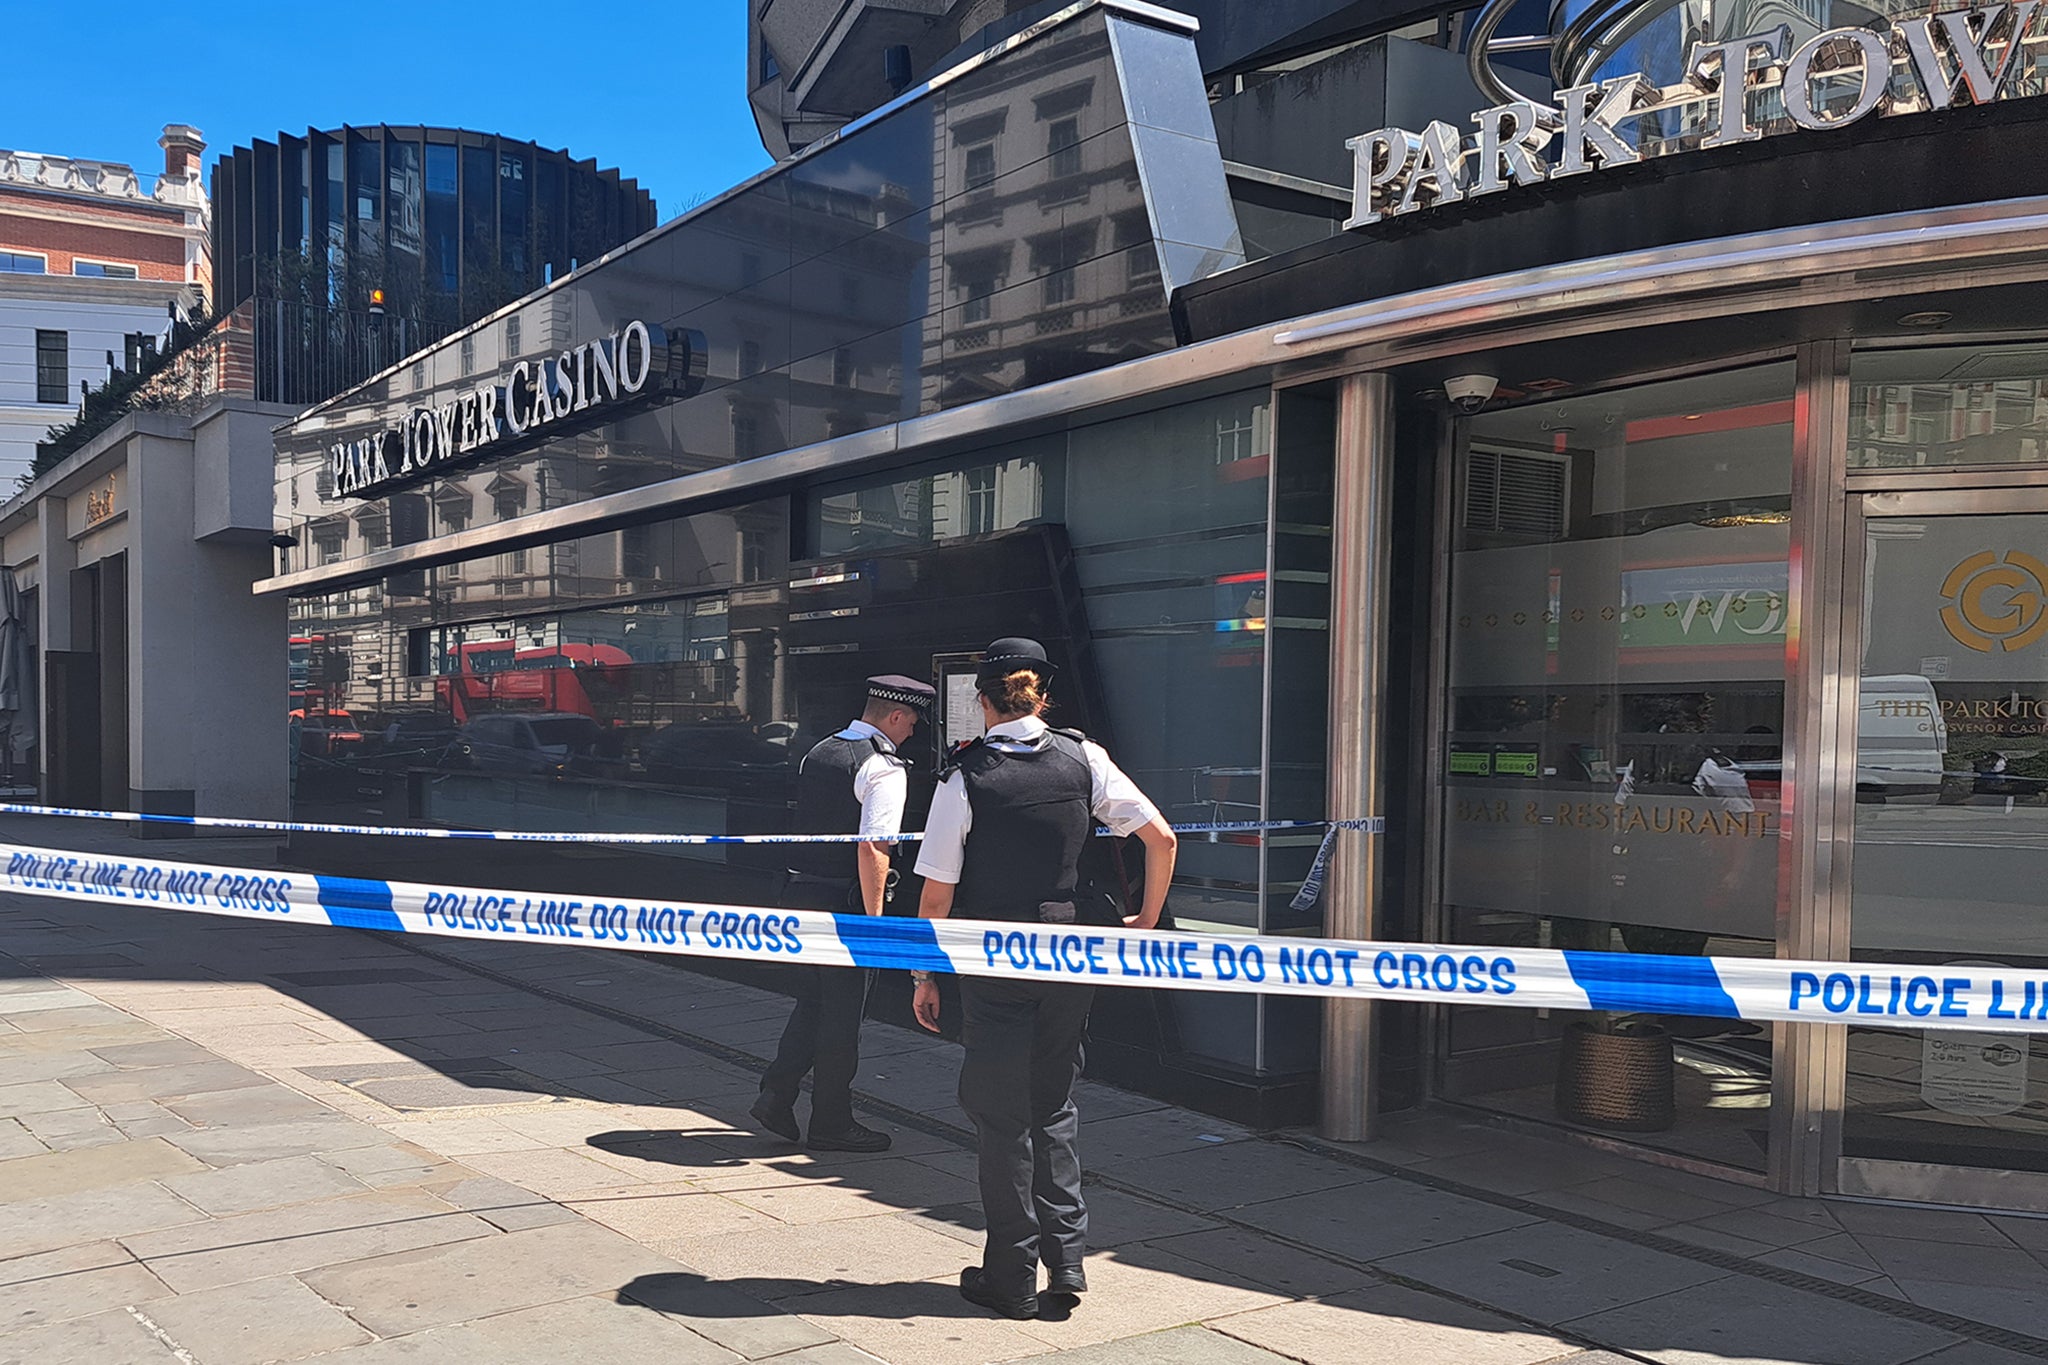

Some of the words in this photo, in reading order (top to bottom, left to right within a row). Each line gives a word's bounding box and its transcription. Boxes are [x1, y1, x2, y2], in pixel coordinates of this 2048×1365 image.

[1342, 72, 1642, 231] PARK
[331, 430, 390, 498] PARK
[398, 384, 499, 473] TOWER
[505, 320, 651, 434] CASINO
[1875, 699, 1930, 718] THE
[1938, 699, 2011, 719] PARK
[1456, 800, 1510, 822] BAR
[1525, 800, 1541, 825] &
[1559, 802, 1772, 839] RESTAURANT
[8, 852, 77, 891] POLICE
[82, 859, 127, 896] LINE
[131, 866, 163, 900] DO
[165, 869, 212, 905] NOT
[214, 873, 292, 914] CROSS
[423, 891, 516, 933] POLICE
[521, 898, 584, 938] LINE
[588, 904, 629, 942] DO
[636, 907, 695, 945] NOT
[701, 910, 803, 954] CROSS
[983, 930, 1108, 974] POLICE
[1116, 938, 1202, 979] LINE
[1212, 943, 1265, 983] DO
[1279, 947, 1360, 987] NOT
[1373, 951, 1517, 995] CROSS
[1788, 971, 1972, 1017] POLICE
